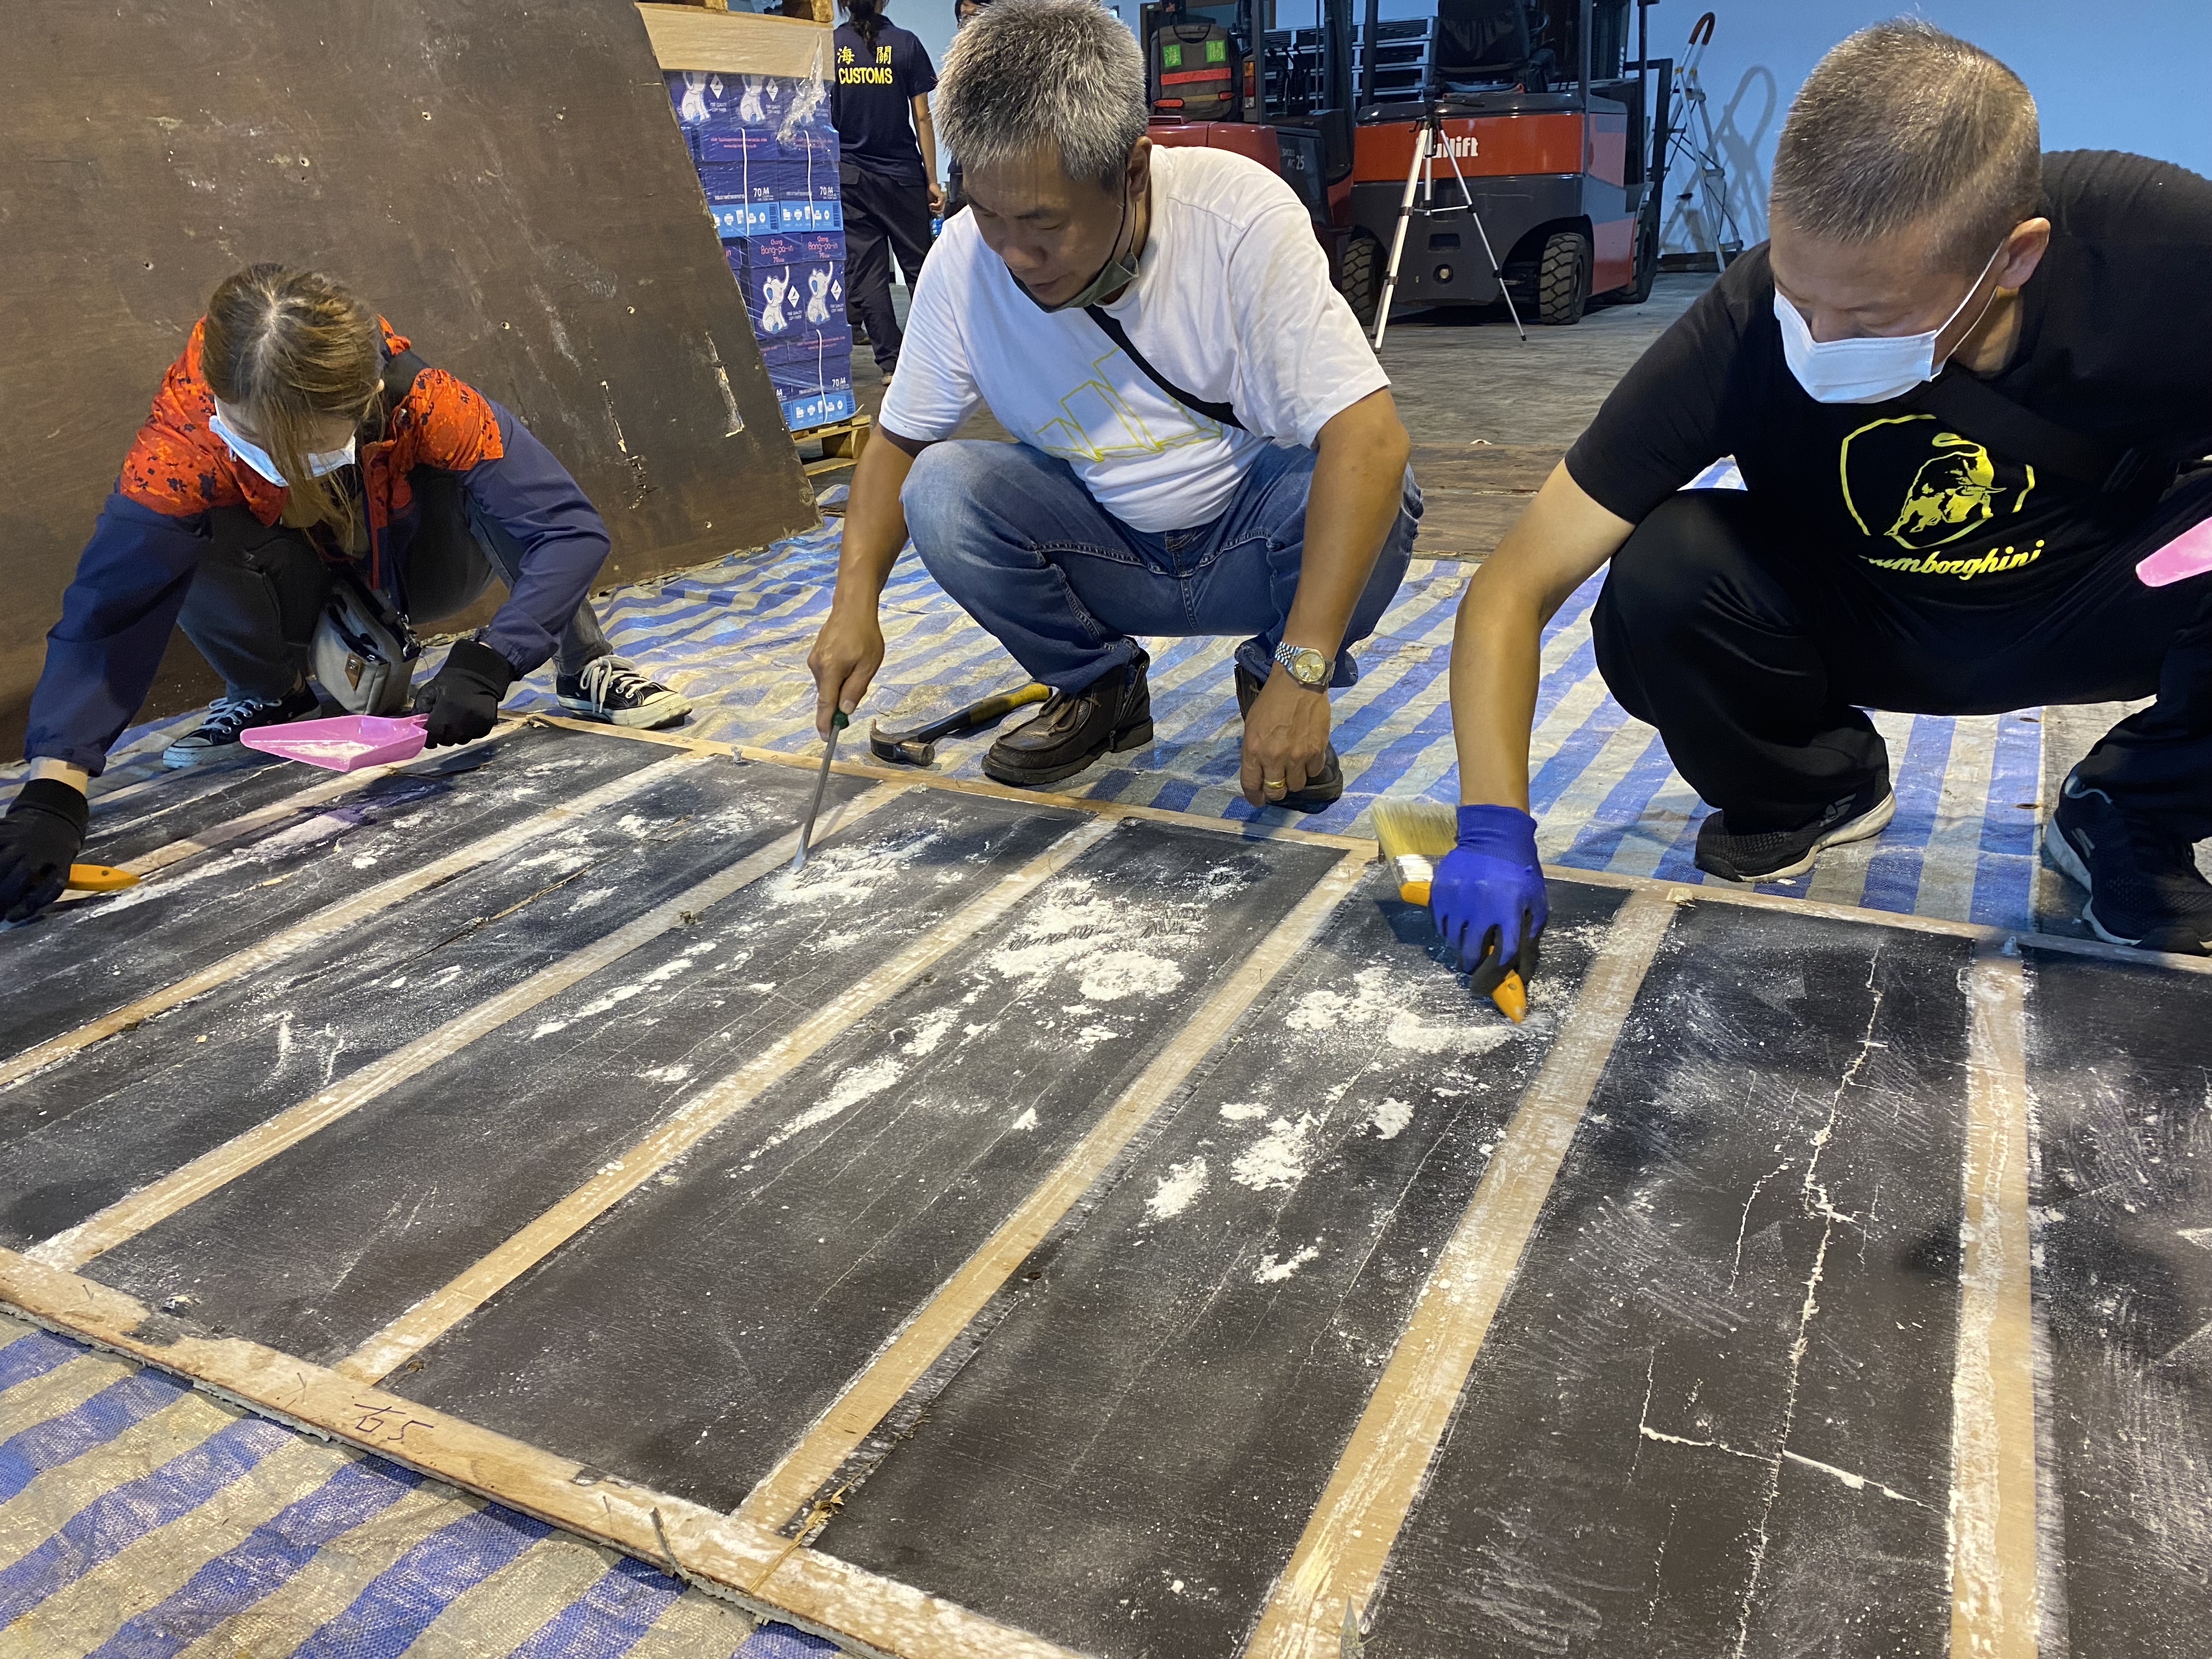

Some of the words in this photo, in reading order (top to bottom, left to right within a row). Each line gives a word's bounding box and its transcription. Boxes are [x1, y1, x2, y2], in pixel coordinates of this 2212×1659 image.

[838, 67, 893, 84] CUSTOMS
[1296, 155, 1304, 170] 25
[753, 188, 761, 198] 70
[820, 187, 827, 195] 70
[760, 245, 793, 256] Bang-pa-in
[832, 379, 839, 388] 70
